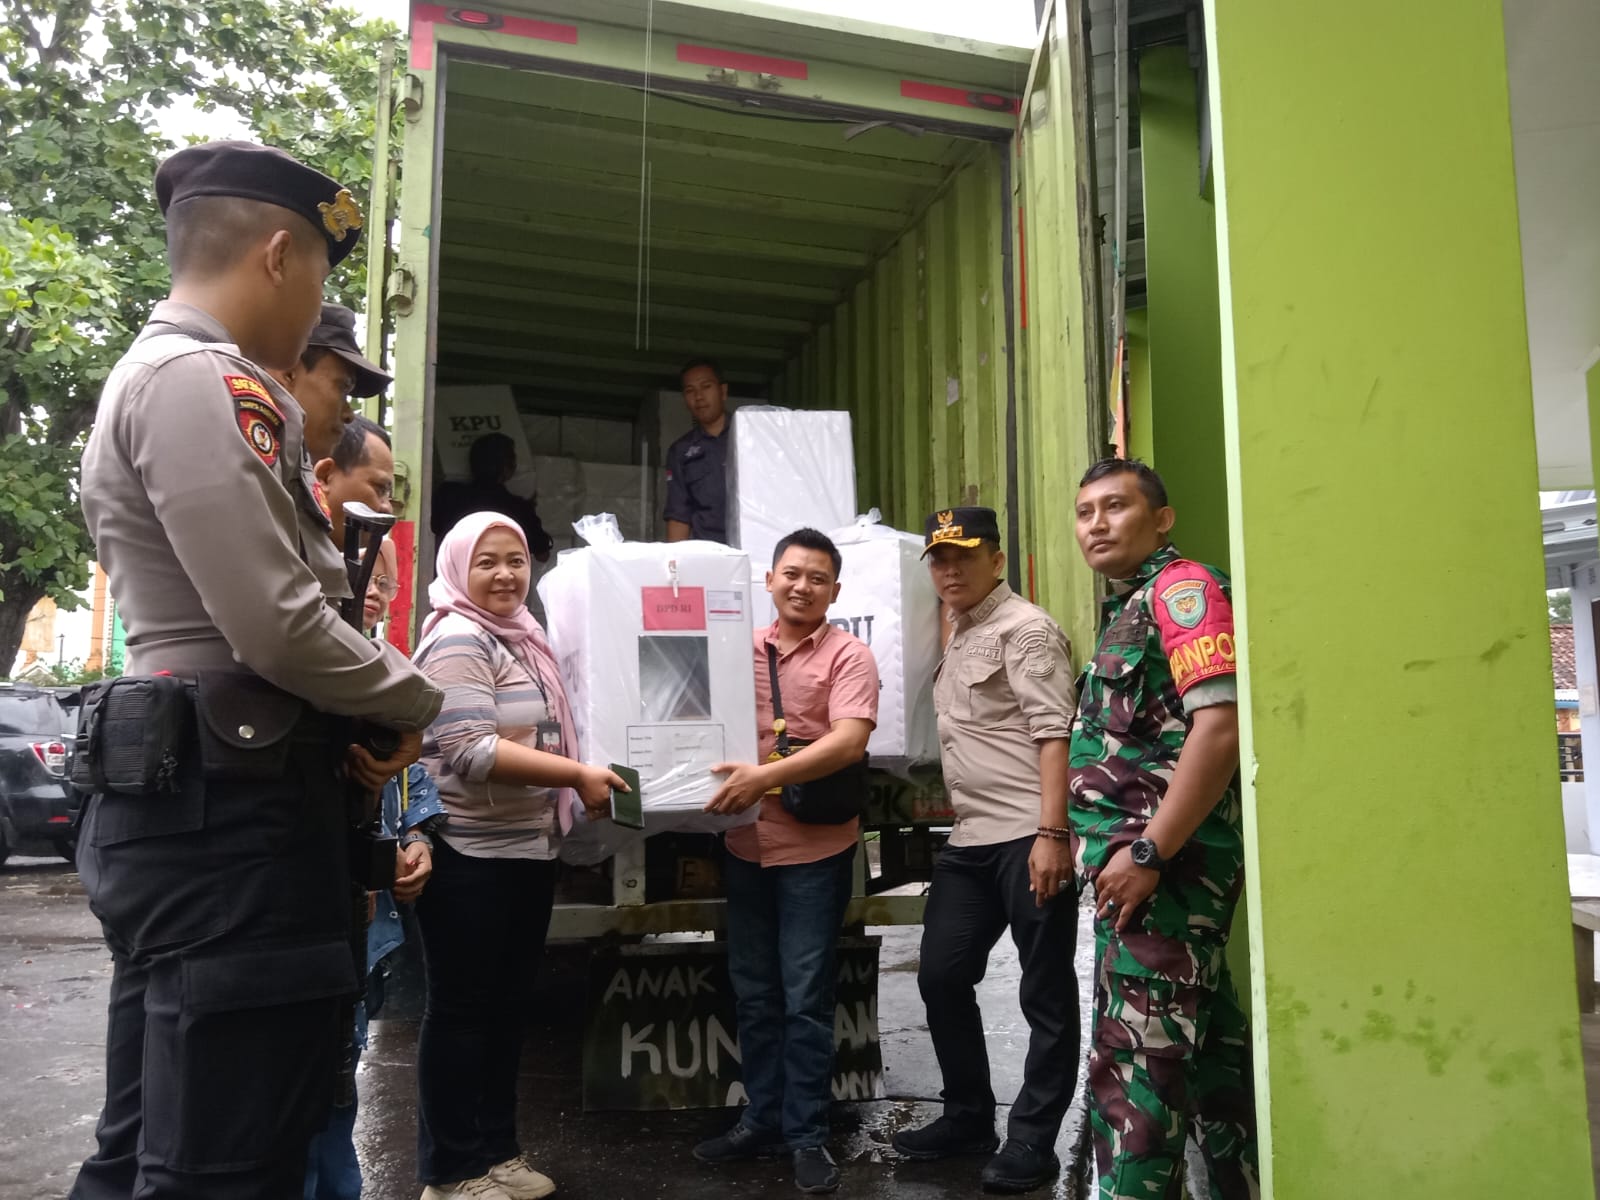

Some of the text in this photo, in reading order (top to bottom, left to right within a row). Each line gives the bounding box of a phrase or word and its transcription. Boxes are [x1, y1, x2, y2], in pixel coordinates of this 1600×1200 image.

[448, 416, 502, 431] KPU
[829, 616, 875, 648] PU
[967, 646, 999, 659] CAMAT
[1169, 632, 1237, 685] ANPO
[603, 965, 718, 1006] ANAK
